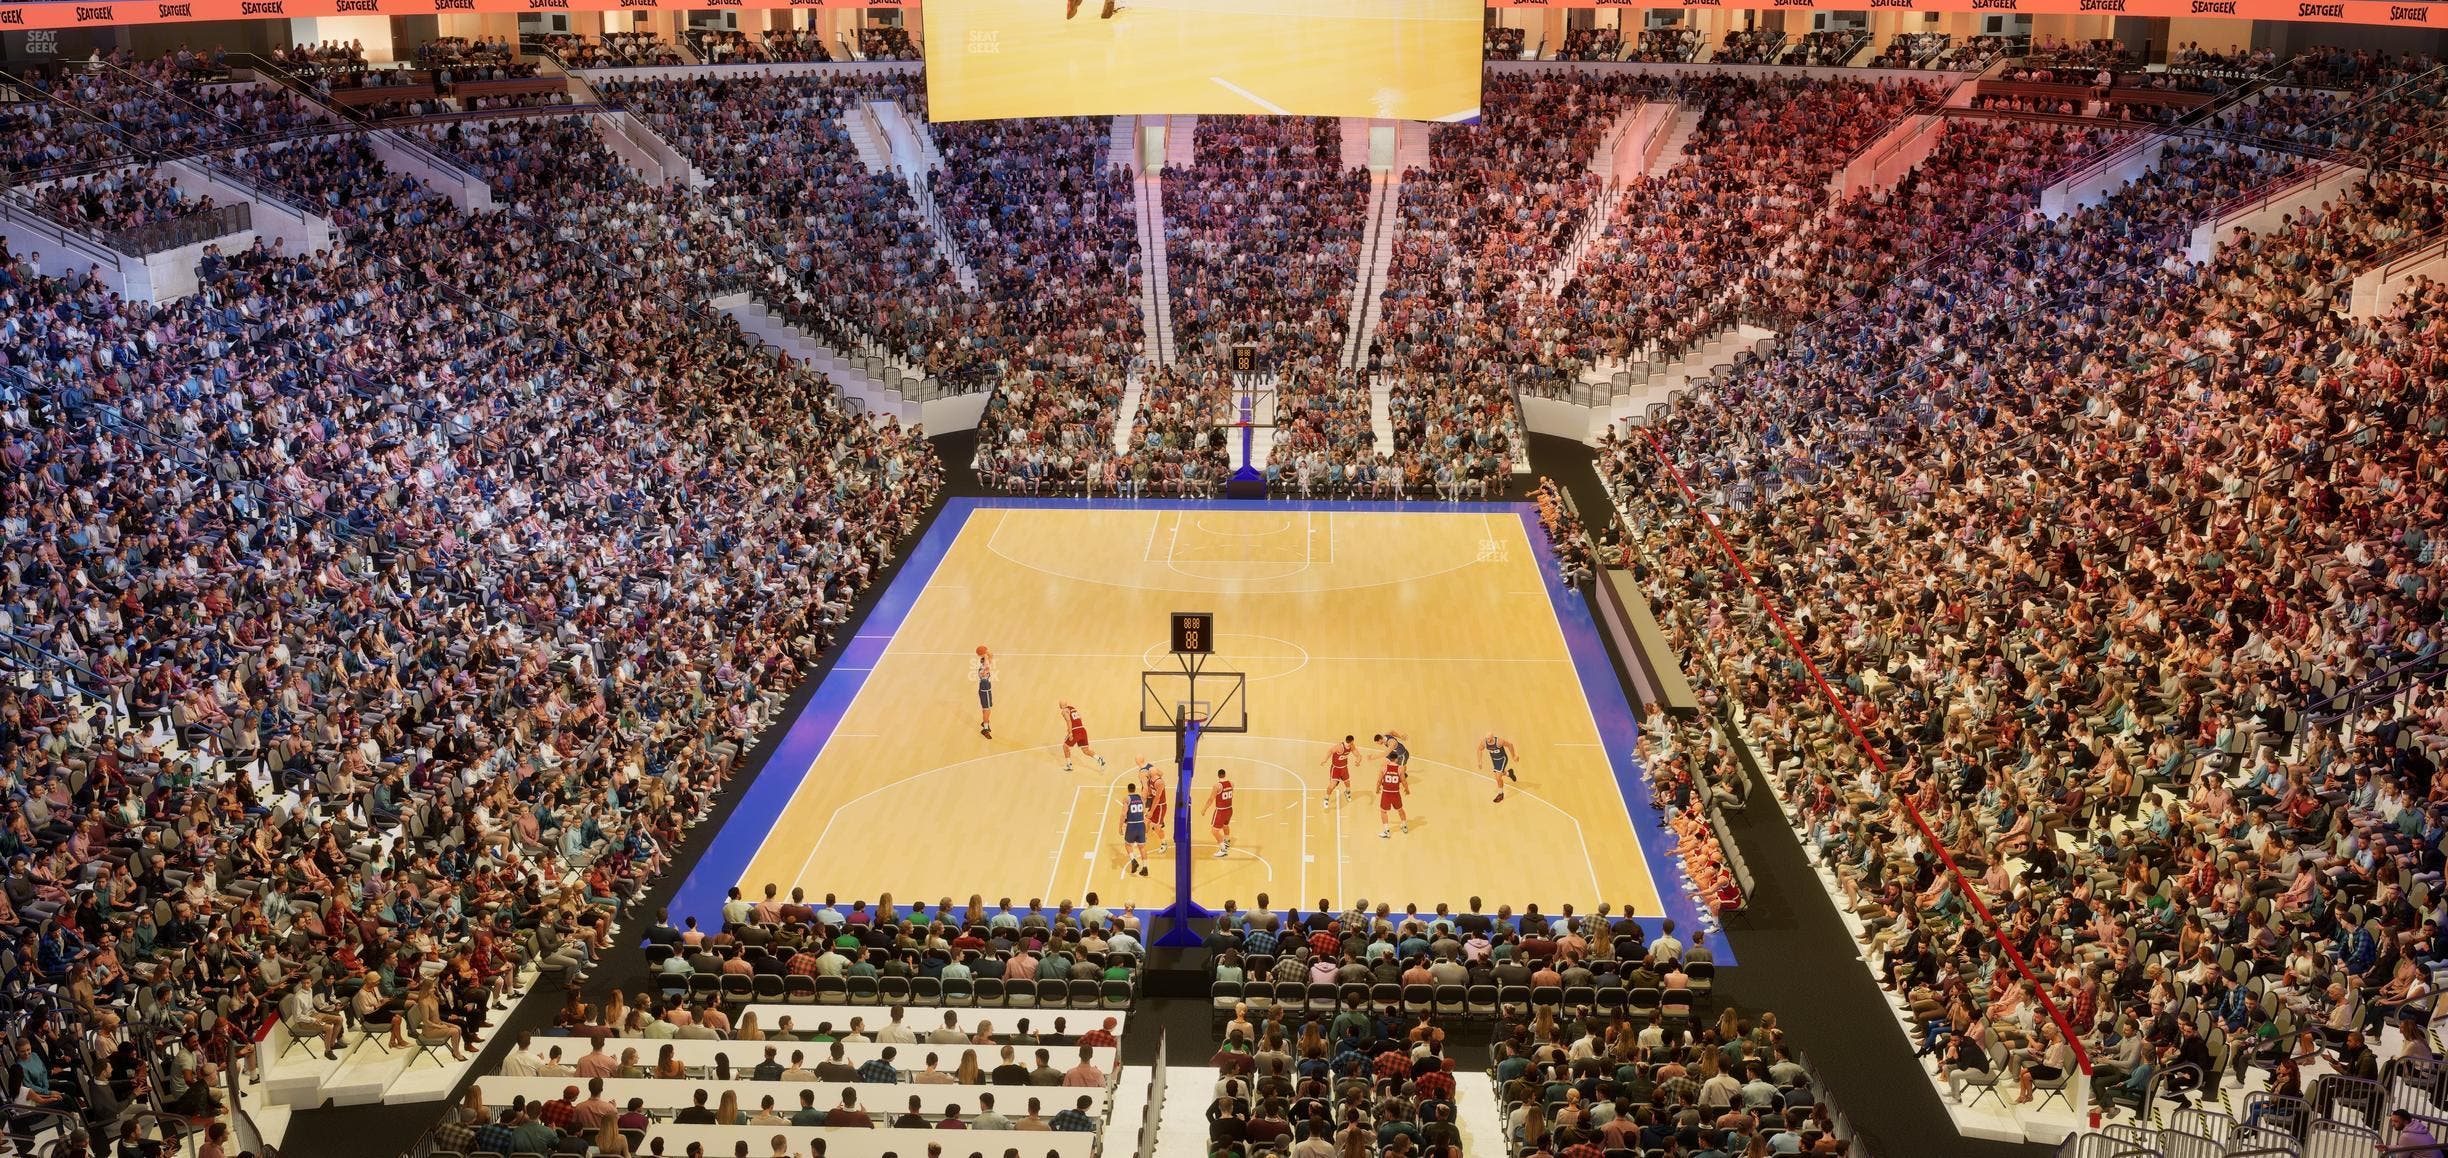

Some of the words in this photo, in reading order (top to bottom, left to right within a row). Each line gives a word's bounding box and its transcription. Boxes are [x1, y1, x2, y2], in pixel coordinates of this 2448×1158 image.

[159, 3, 192, 18] SEATGEEK
[241, 1, 284, 15] SEATGEEK
[336, 0, 379, 12] SEATGEEK
[434, 0, 476, 10] SEATGEEK
[1972, 0, 2017, 9] SEATGEEK
[2079, 0, 2126, 11] SEATGEEK
[2191, 0, 2236, 15] SEATGEEK
[2298, 3, 2344, 19] SEATGEEK
[0, 8, 24, 24] GEEK
[76, 6, 114, 22] SEATGEEK
[2390, 6, 2428, 22] SEATGEEK
[1185, 631, 1199, 649] 88
[1384, 775, 1399, 784] 00
[1222, 791, 1233, 800] 00
[1130, 804, 1143, 813] 00
